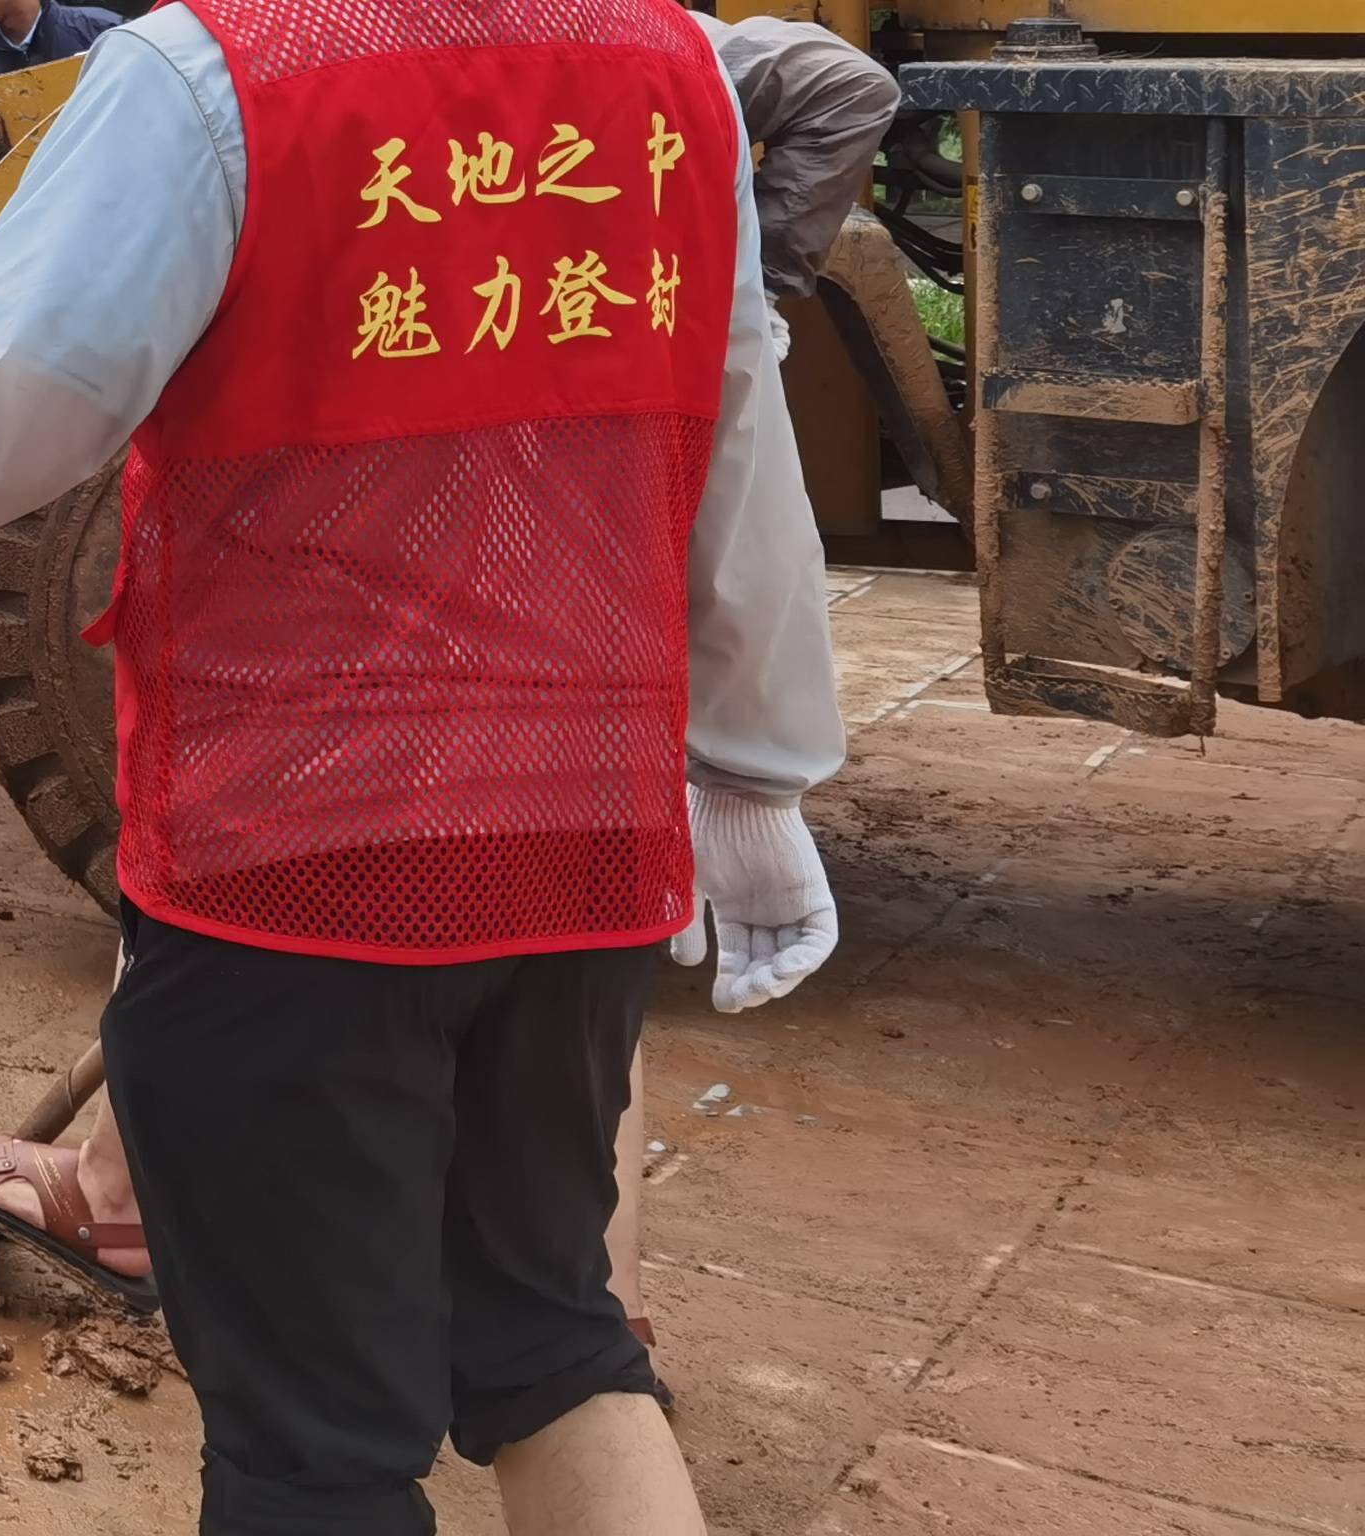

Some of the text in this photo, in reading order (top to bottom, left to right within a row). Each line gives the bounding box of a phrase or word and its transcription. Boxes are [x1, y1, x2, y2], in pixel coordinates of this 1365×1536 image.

[356, 112, 686, 228] 天地之中
[351, 248, 682, 360] 魅力登封
